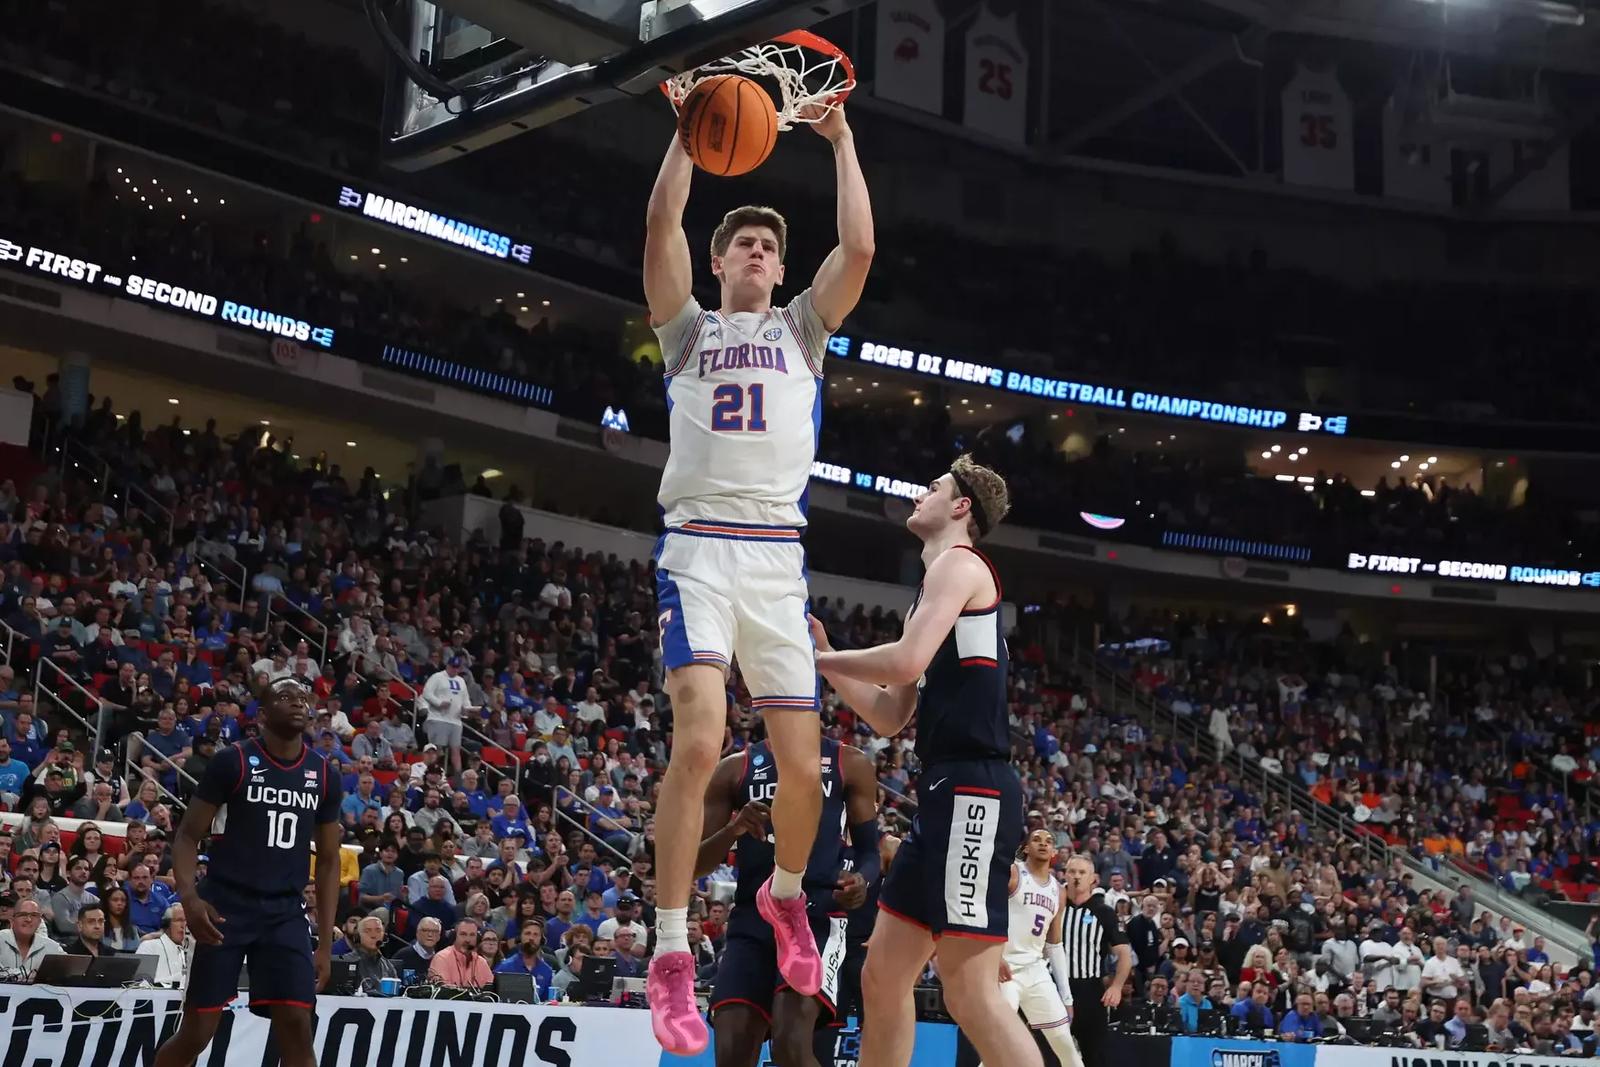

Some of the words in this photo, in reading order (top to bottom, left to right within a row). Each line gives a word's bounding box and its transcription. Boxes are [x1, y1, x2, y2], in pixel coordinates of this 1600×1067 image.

[978, 58, 1013, 100] 25
[1299, 113, 1338, 149] 35
[26, 246, 102, 283] FIRST
[103, 274, 122, 287] AND
[126, 274, 218, 316] SECOND
[221, 301, 311, 342] ROUNDS
[698, 342, 788, 379] FLORIDA
[859, 341, 915, 370] 2025
[917, 353, 941, 375] DI
[944, 358, 1004, 388] MEN'S
[1007, 370, 1127, 408] BASKETBALL
[1130, 391, 1288, 429] CHAMPIONSHIP
[711, 383, 767, 432] 21
[856, 472, 873, 488] VS
[1368, 554, 1421, 573] FIRST
[1438, 560, 1507, 580] SECOND
[1510, 566, 1582, 586] ROUNDS
[247, 785, 319, 811] UCONN
[267, 810, 299, 849] 10
[959, 803, 986, 918] HUSKIES
[1031, 914, 1045, 937] 5
